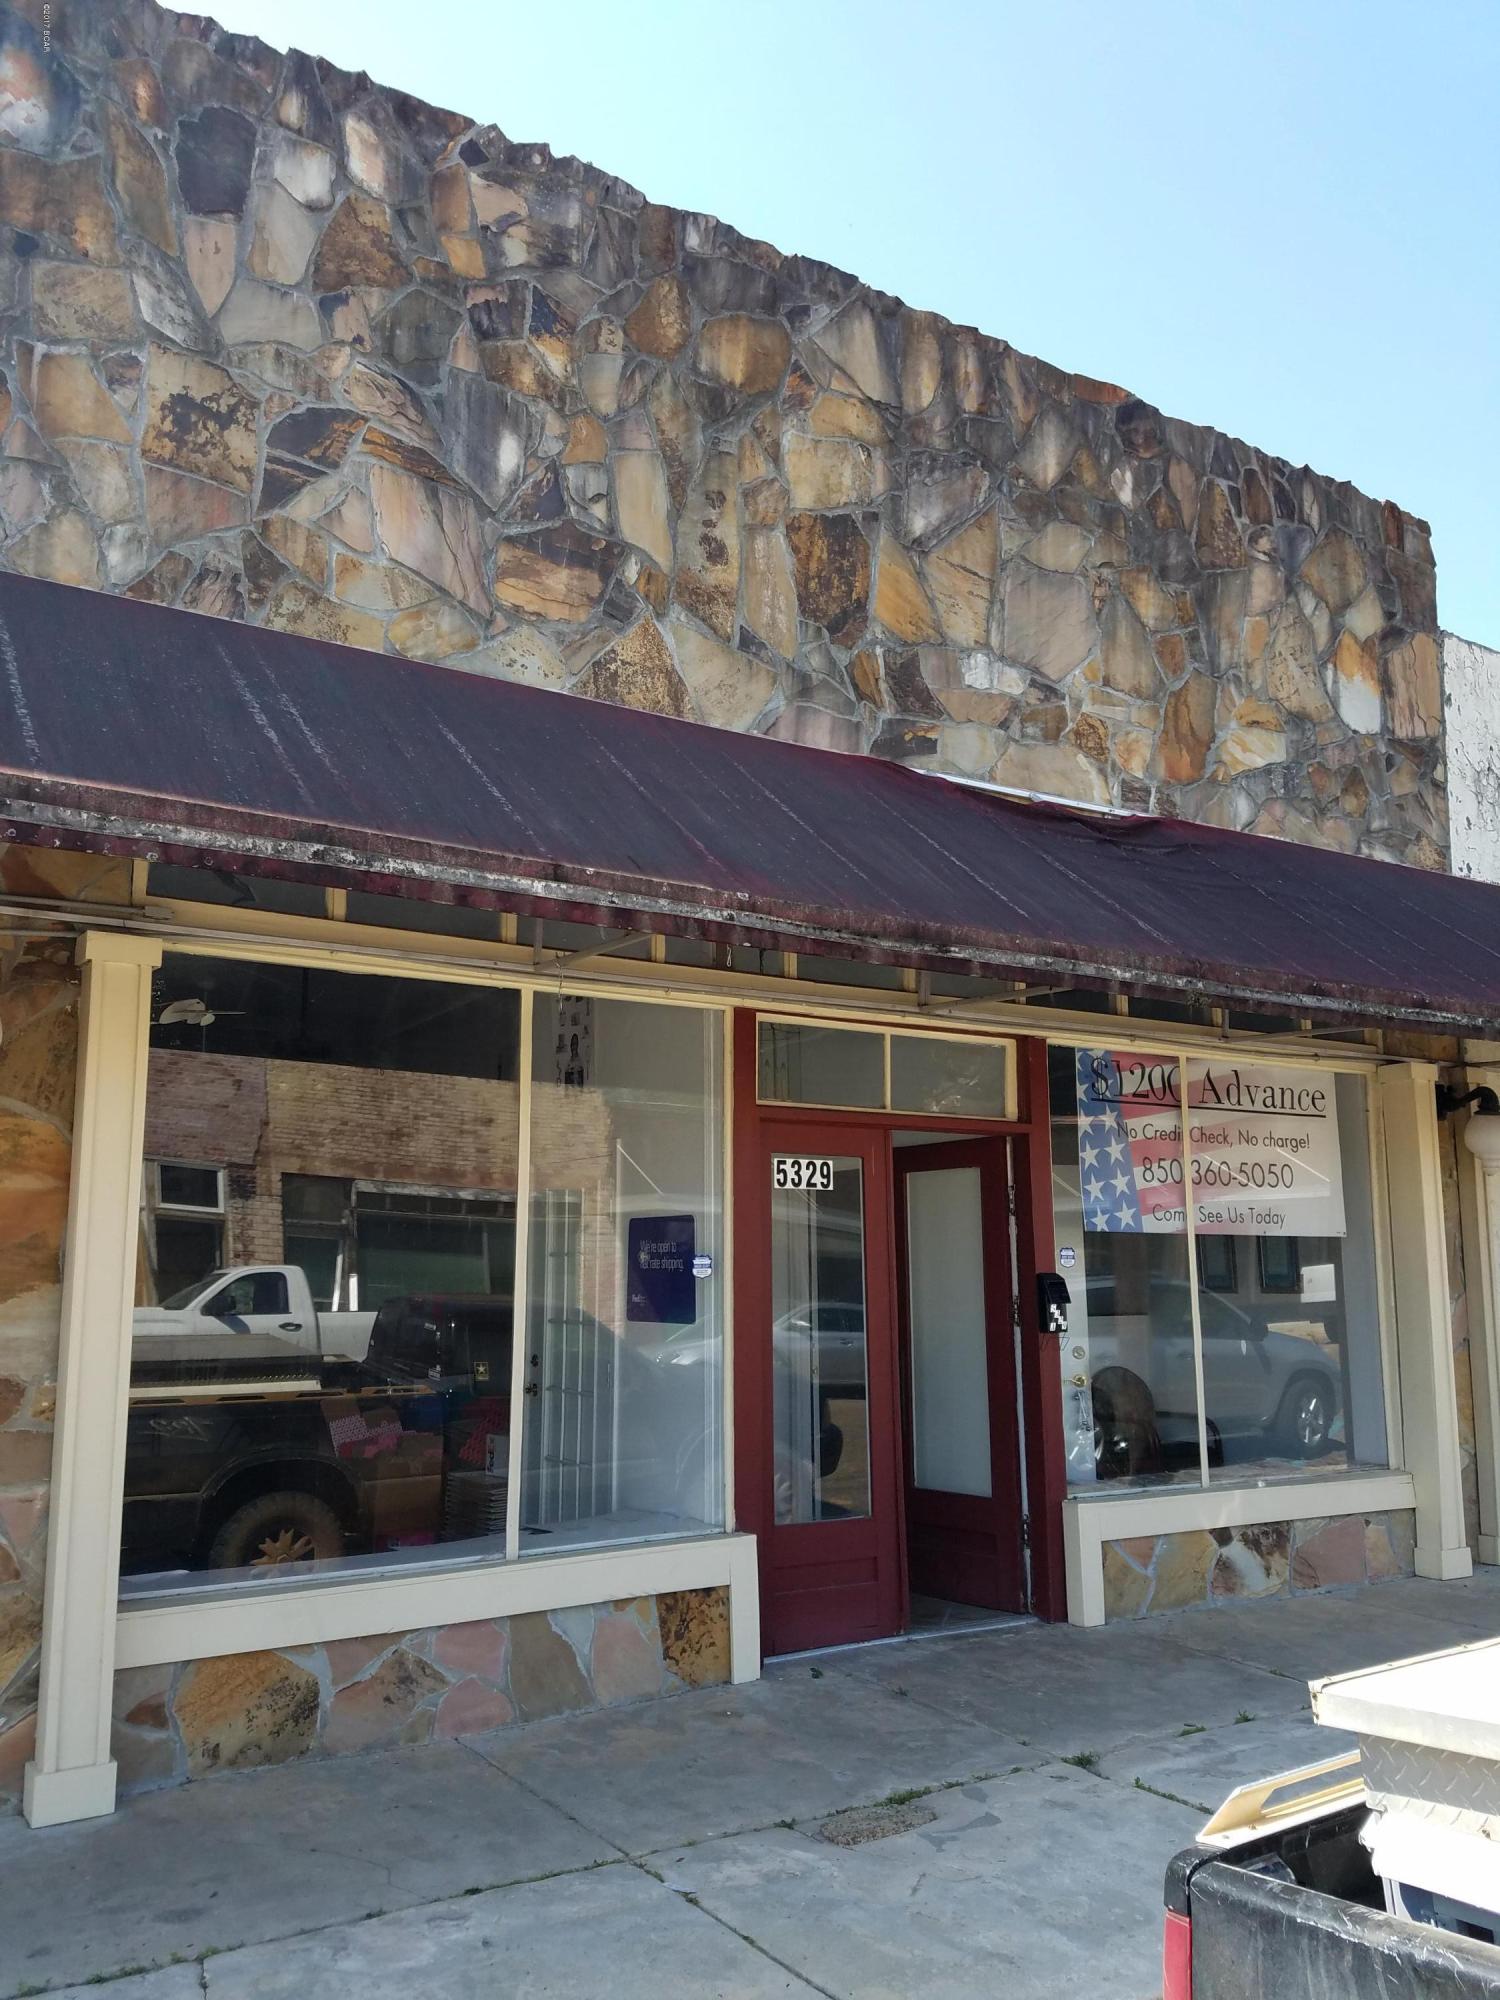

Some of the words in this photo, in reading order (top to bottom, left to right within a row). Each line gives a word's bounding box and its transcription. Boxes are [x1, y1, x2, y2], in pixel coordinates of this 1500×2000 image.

[1199, 1068, 1326, 1113] Advance
[1117, 1122, 1138, 1139] No
[1143, 1124, 1183, 1142] Credi
[1190, 1126, 1233, 1147] Check,
[1238, 1131, 1258, 1146] No
[1262, 1131, 1310, 1152] charge!
[776, 1160, 831, 1189] 5329
[1153, 1204, 1186, 1222] Com
[1199, 1206, 1223, 1223] See
[1228, 1207, 1245, 1223] Us
[1248, 1207, 1286, 1229] Today
